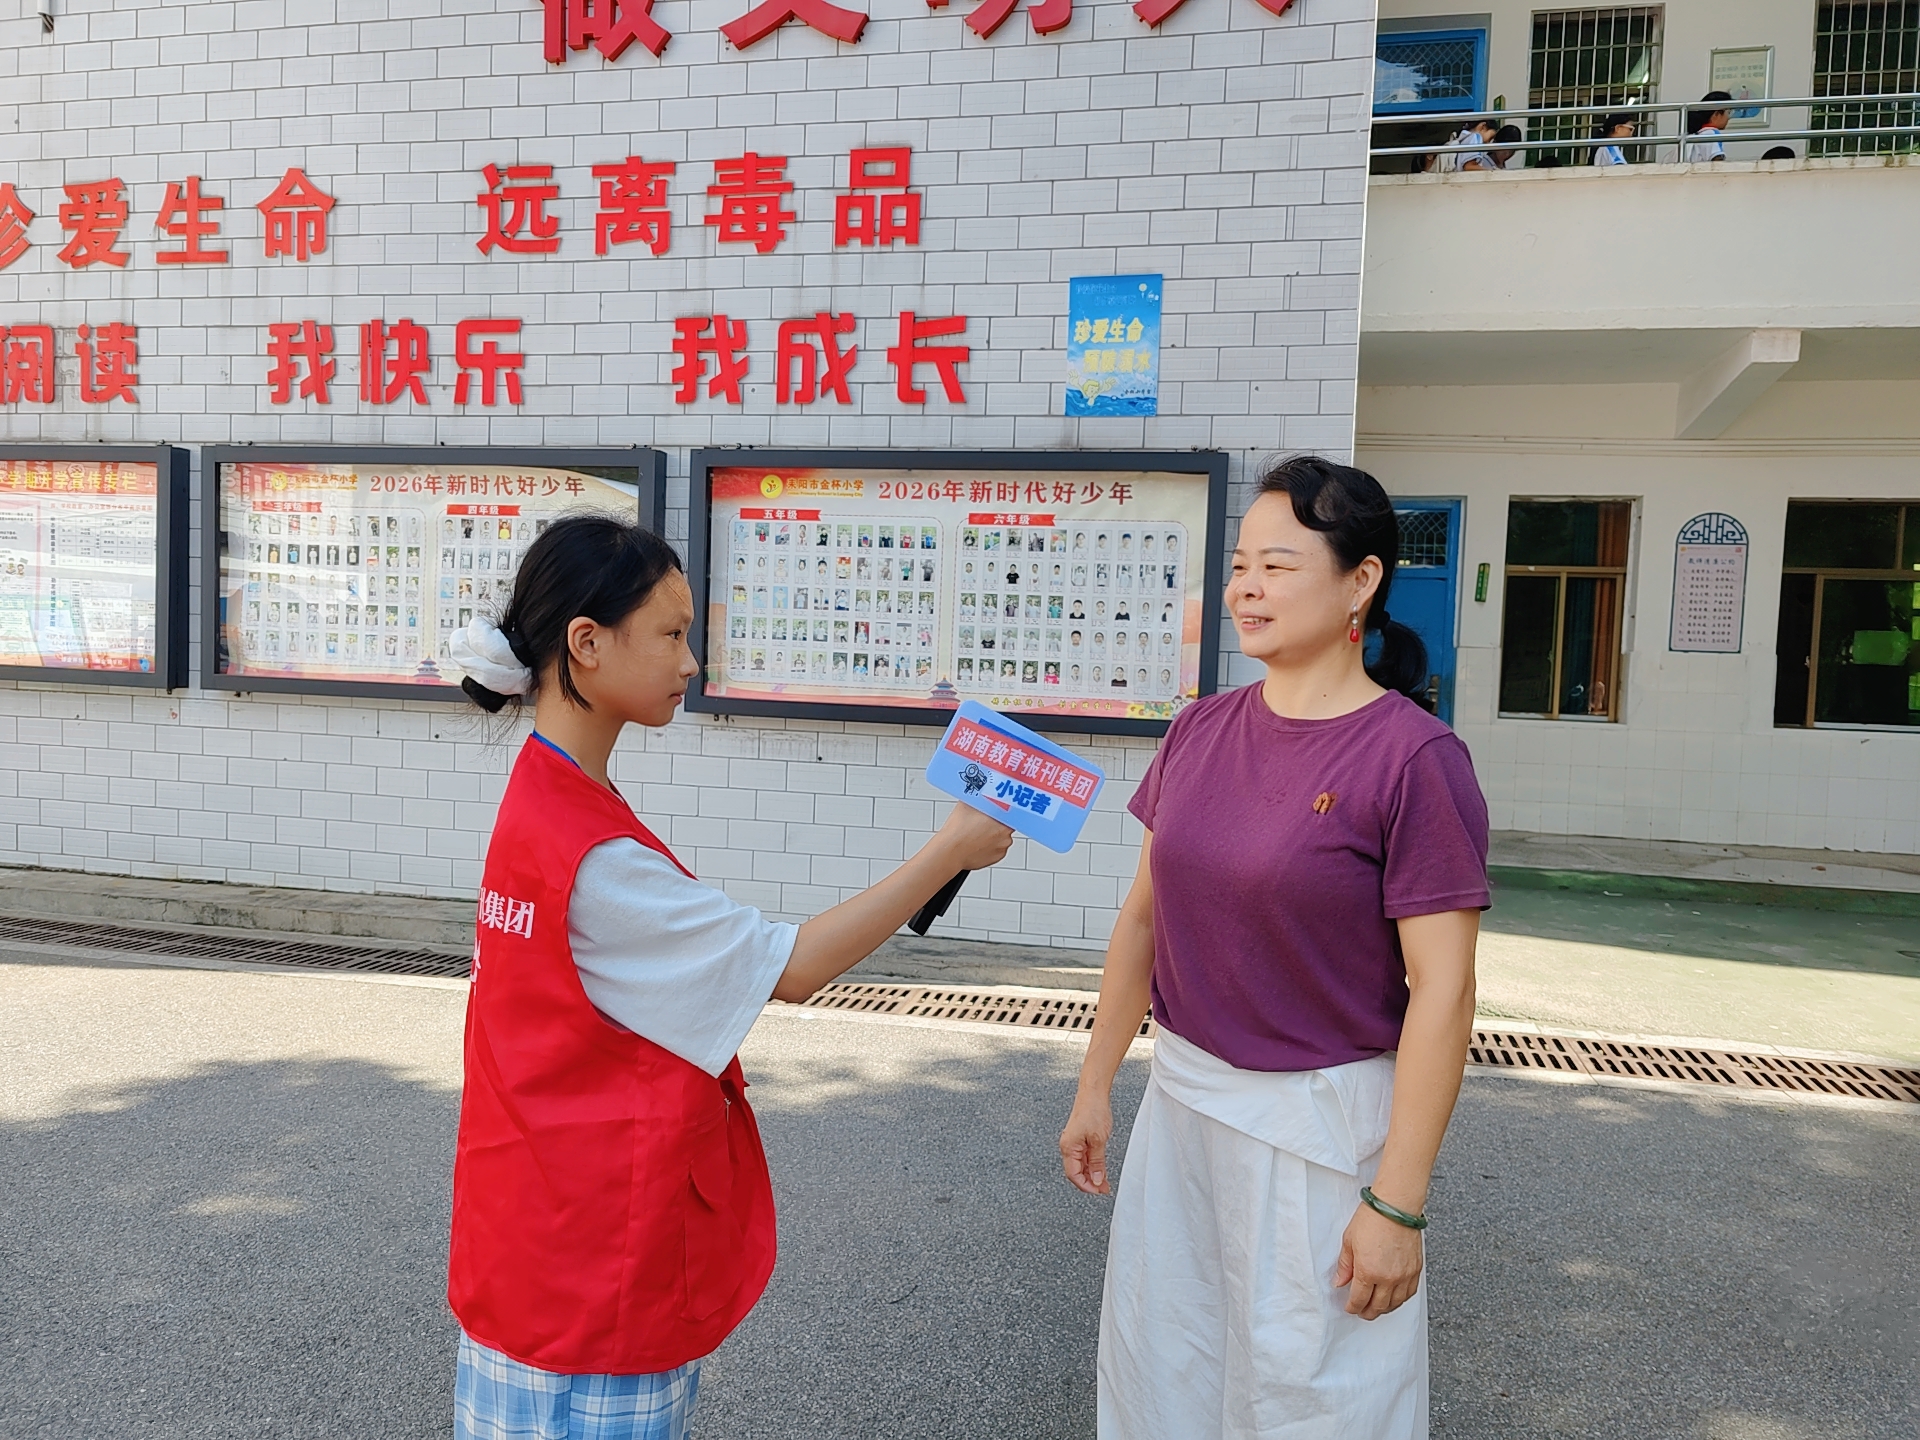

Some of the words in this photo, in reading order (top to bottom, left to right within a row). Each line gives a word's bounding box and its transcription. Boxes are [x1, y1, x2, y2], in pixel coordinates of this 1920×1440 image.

[476, 147, 921, 255] 远离毒品
[1074, 317, 1144, 344] 珍爱生命
[0, 322, 138, 404] 阅读
[267, 319, 523, 406] 我快乐
[671, 311, 968, 404] 我成长
[0, 470, 137, 490] 学期开学宣传专栏
[371, 473, 586, 496] 2026年新时代好少年
[878, 480, 1133, 505] 2026年新时代好少年
[467, 505, 499, 516] 四年级
[763, 509, 797, 520] 五年级
[993, 514, 1030, 525] 六年级
[953, 726, 1094, 801] 湖南教育报刊集团
[995, 779, 1052, 815] 小记者
